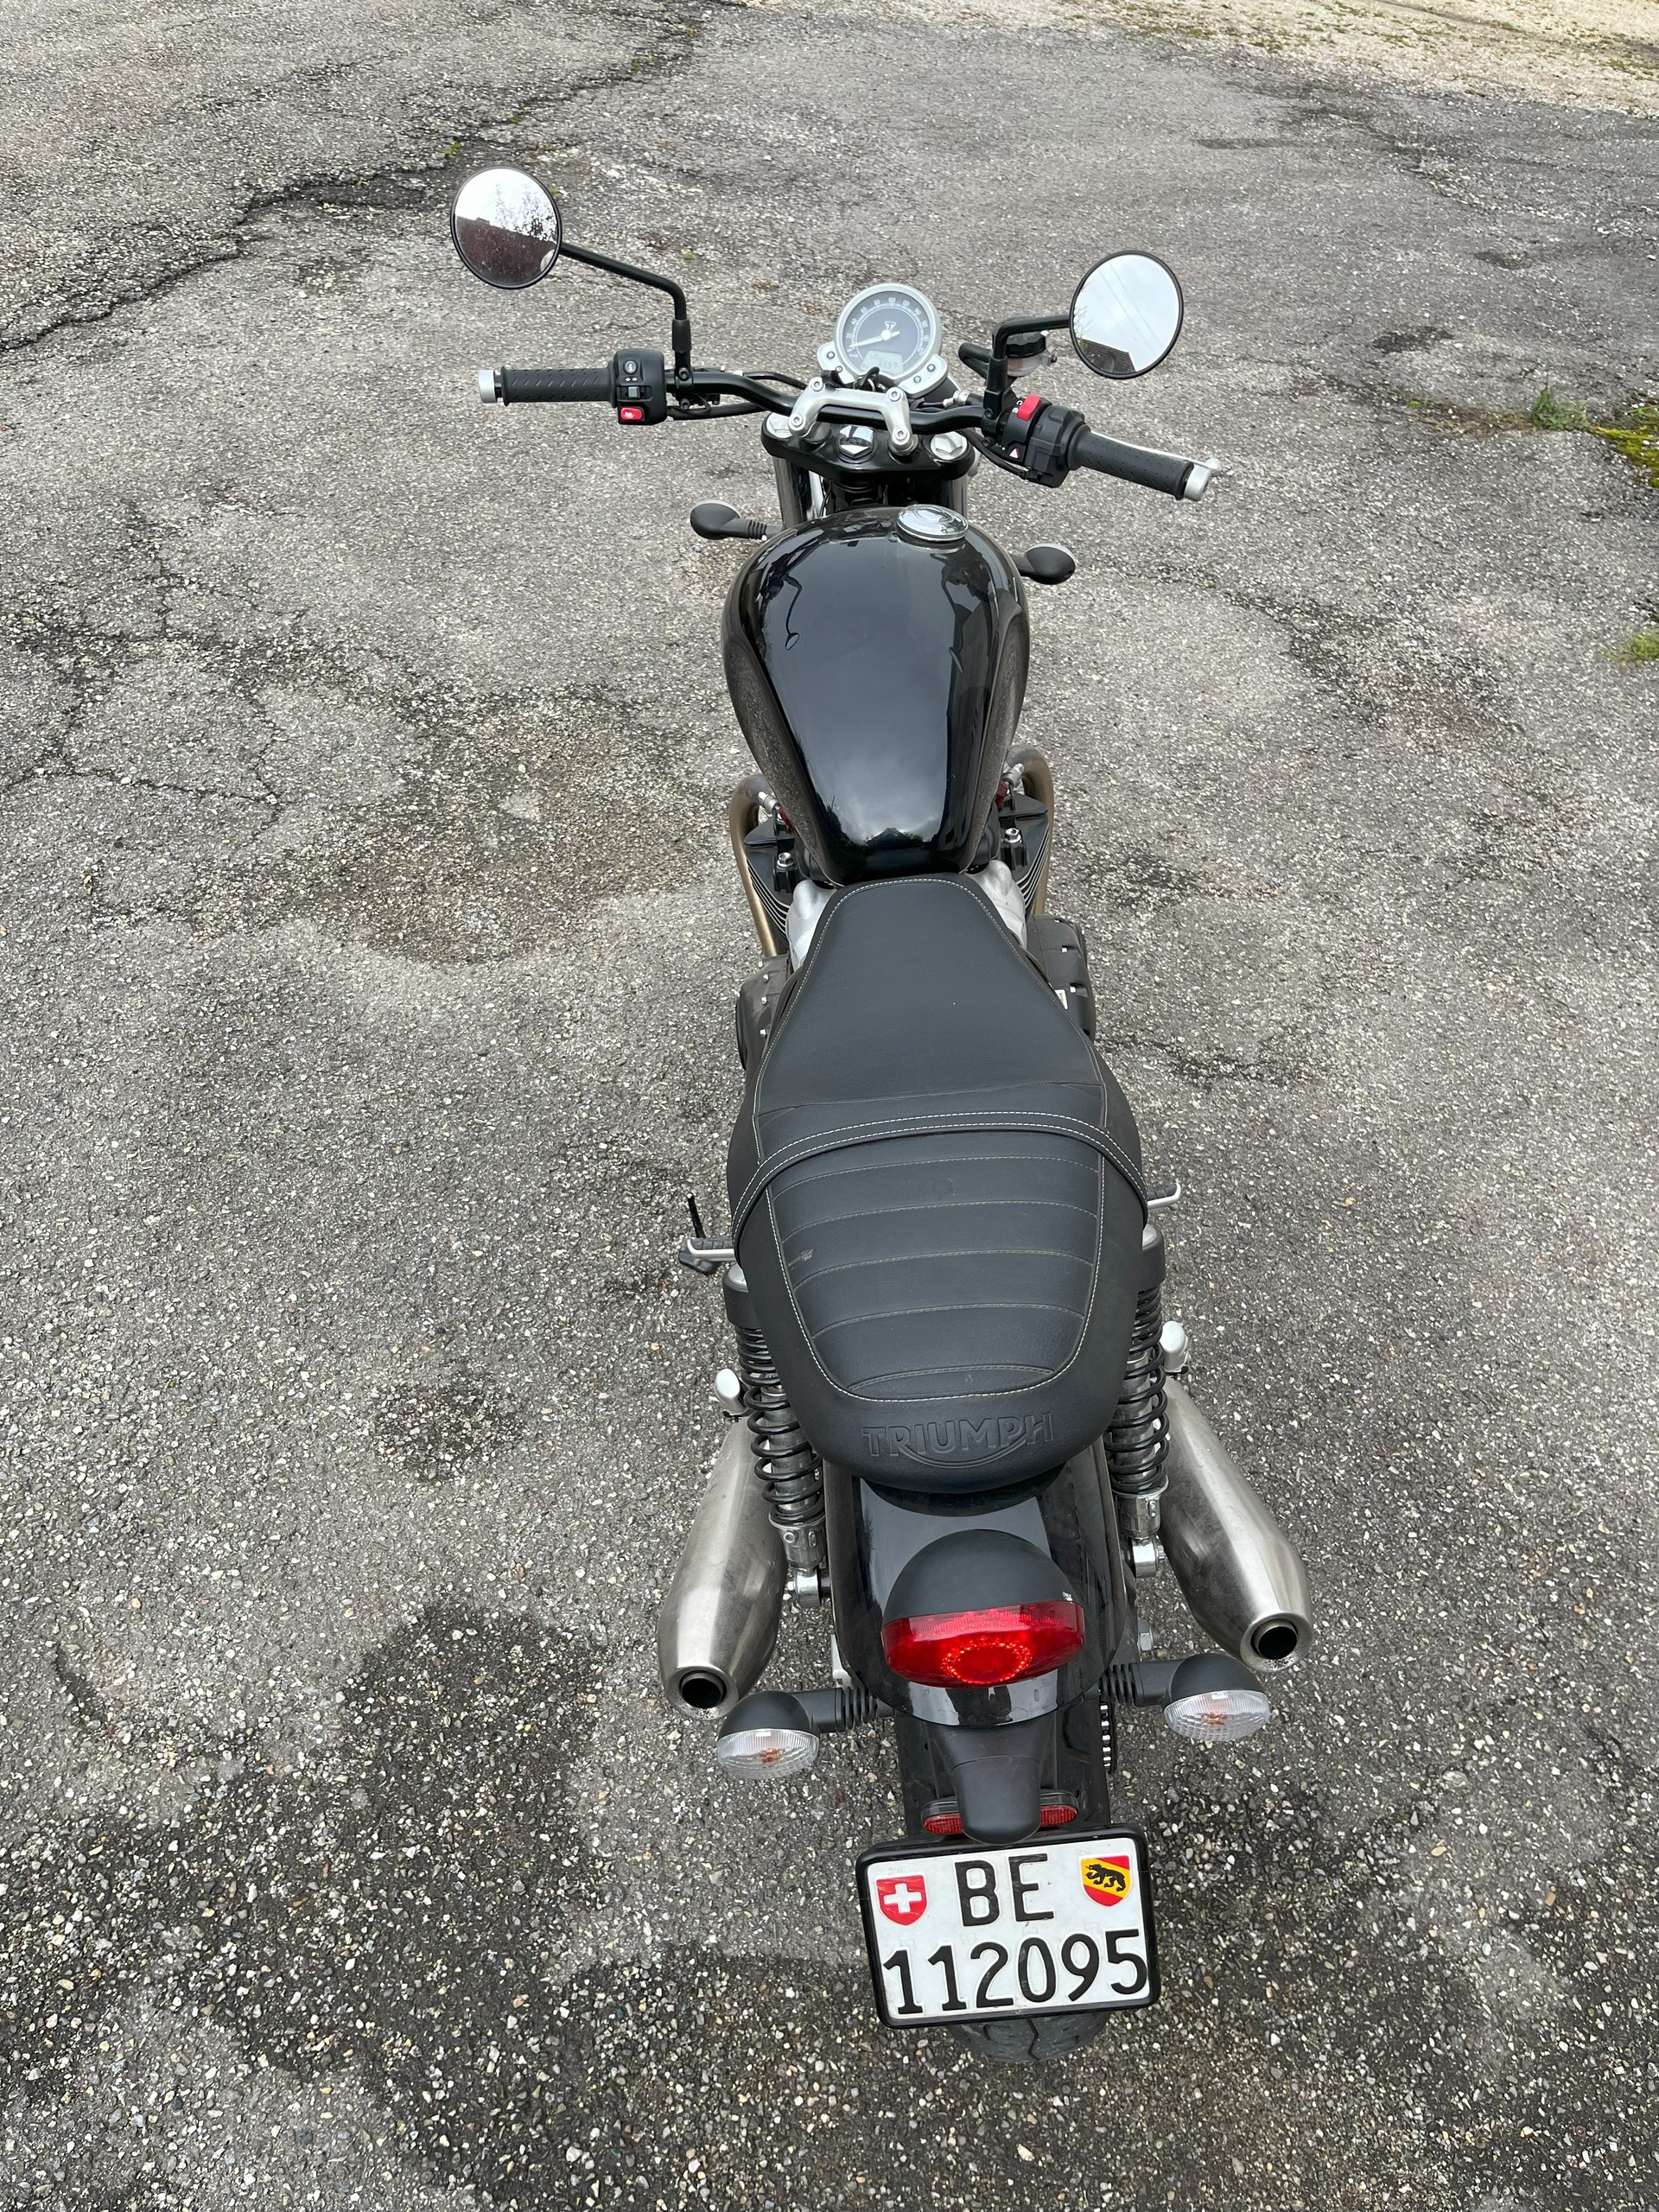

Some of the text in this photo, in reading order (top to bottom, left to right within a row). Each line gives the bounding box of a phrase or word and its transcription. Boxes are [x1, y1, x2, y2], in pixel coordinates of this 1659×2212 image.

[861, 1413, 1053, 1467] TRIUMPH
[954, 1853, 1055, 1927] BE
[883, 1929, 1147, 2015] 112095
